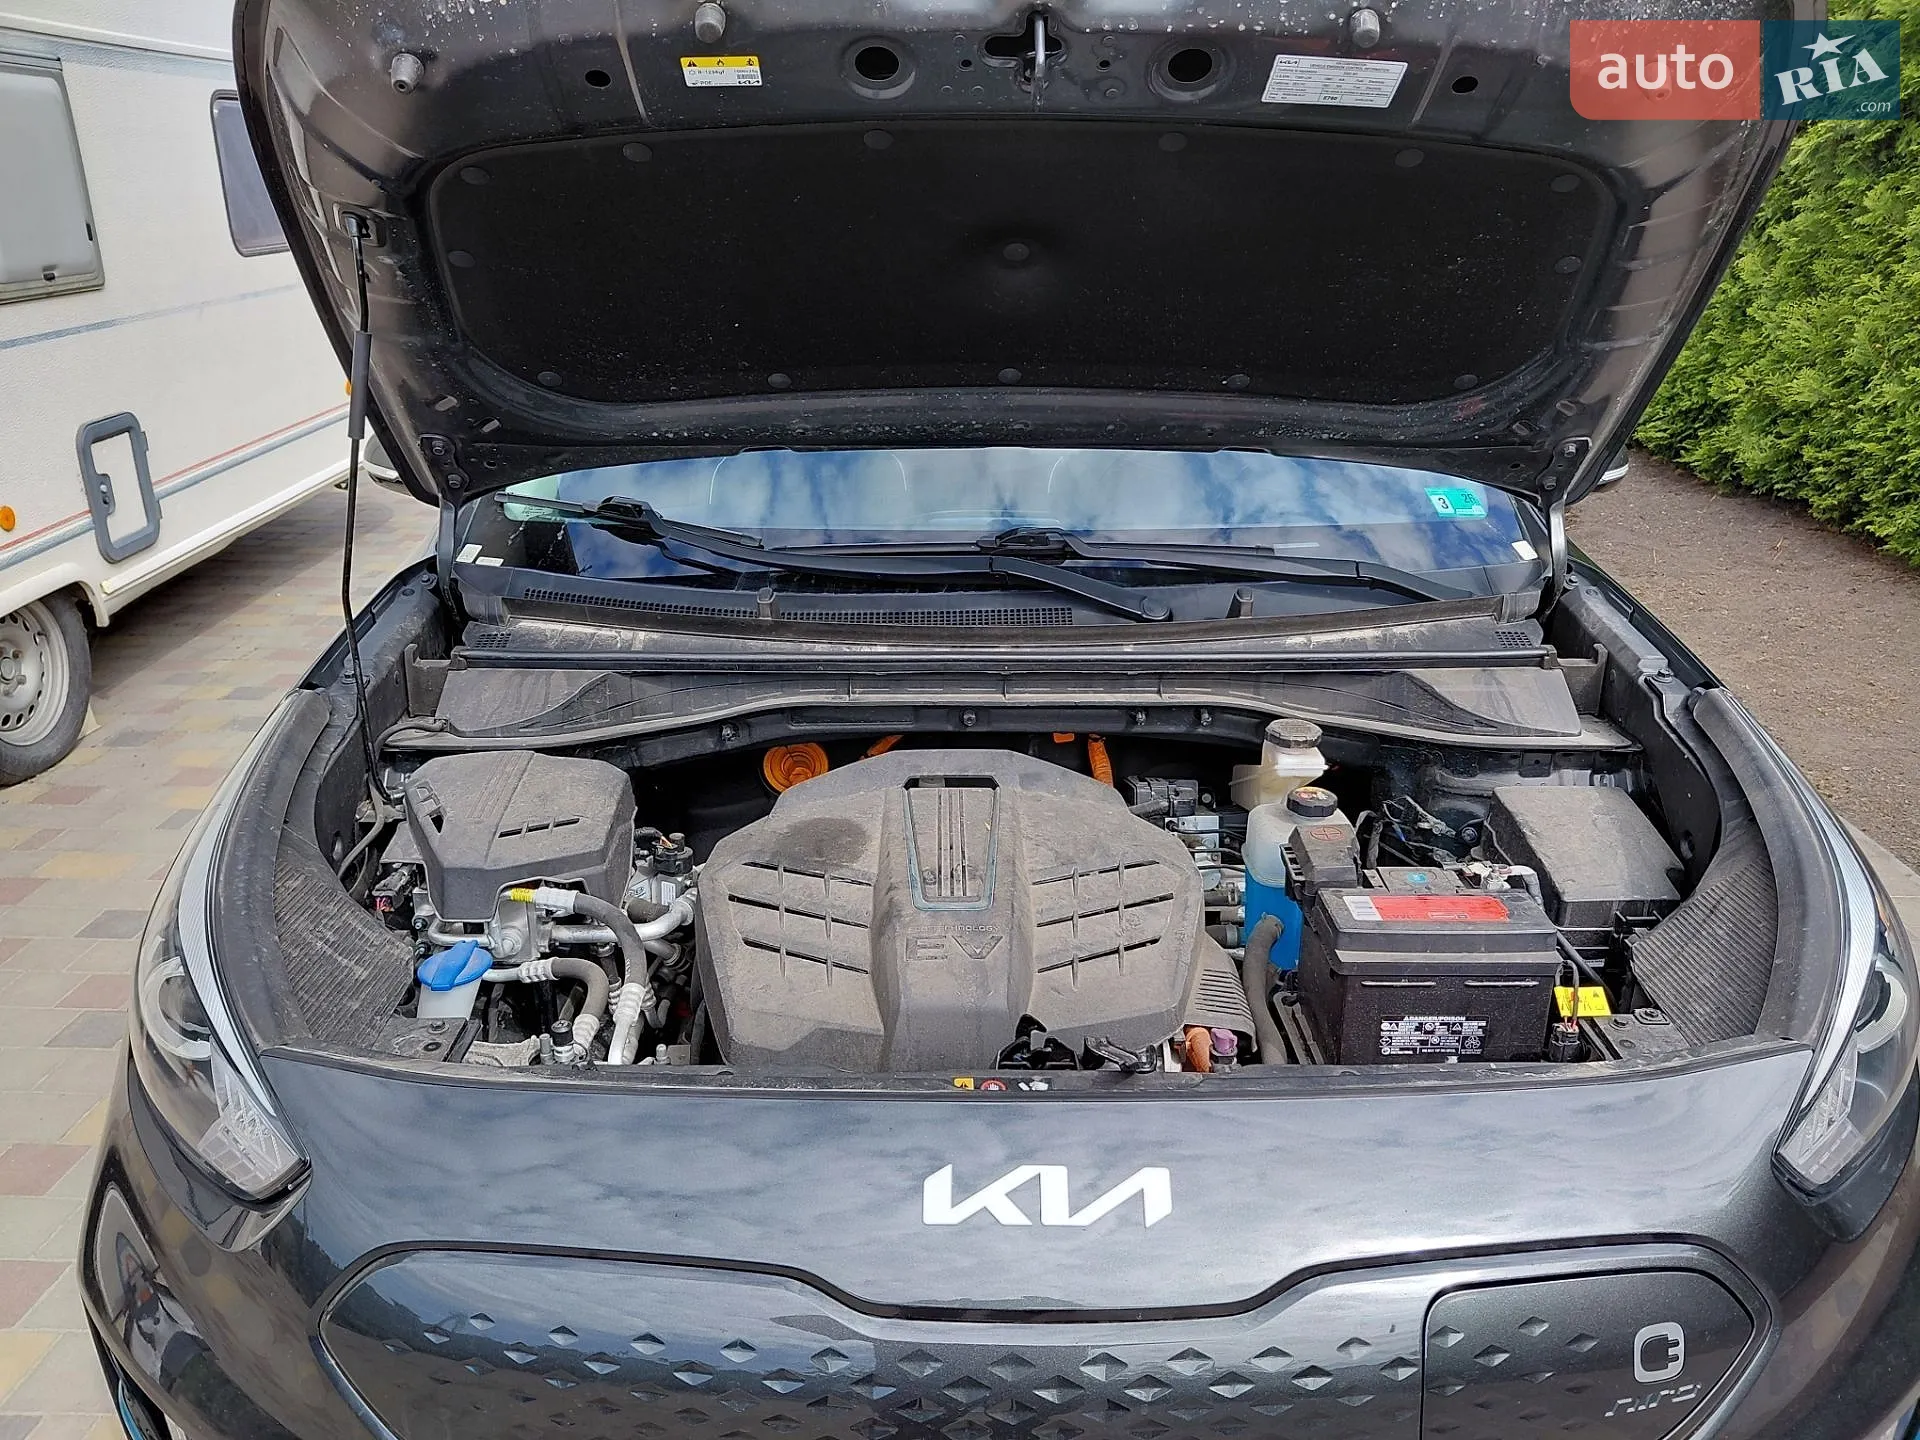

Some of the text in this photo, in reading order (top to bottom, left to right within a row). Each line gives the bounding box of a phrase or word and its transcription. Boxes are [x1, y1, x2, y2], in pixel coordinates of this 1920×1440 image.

[1438, 497, 1449, 509] 3
[904, 935, 1003, 961] EV
[922, 1164, 1173, 1228] KIA
